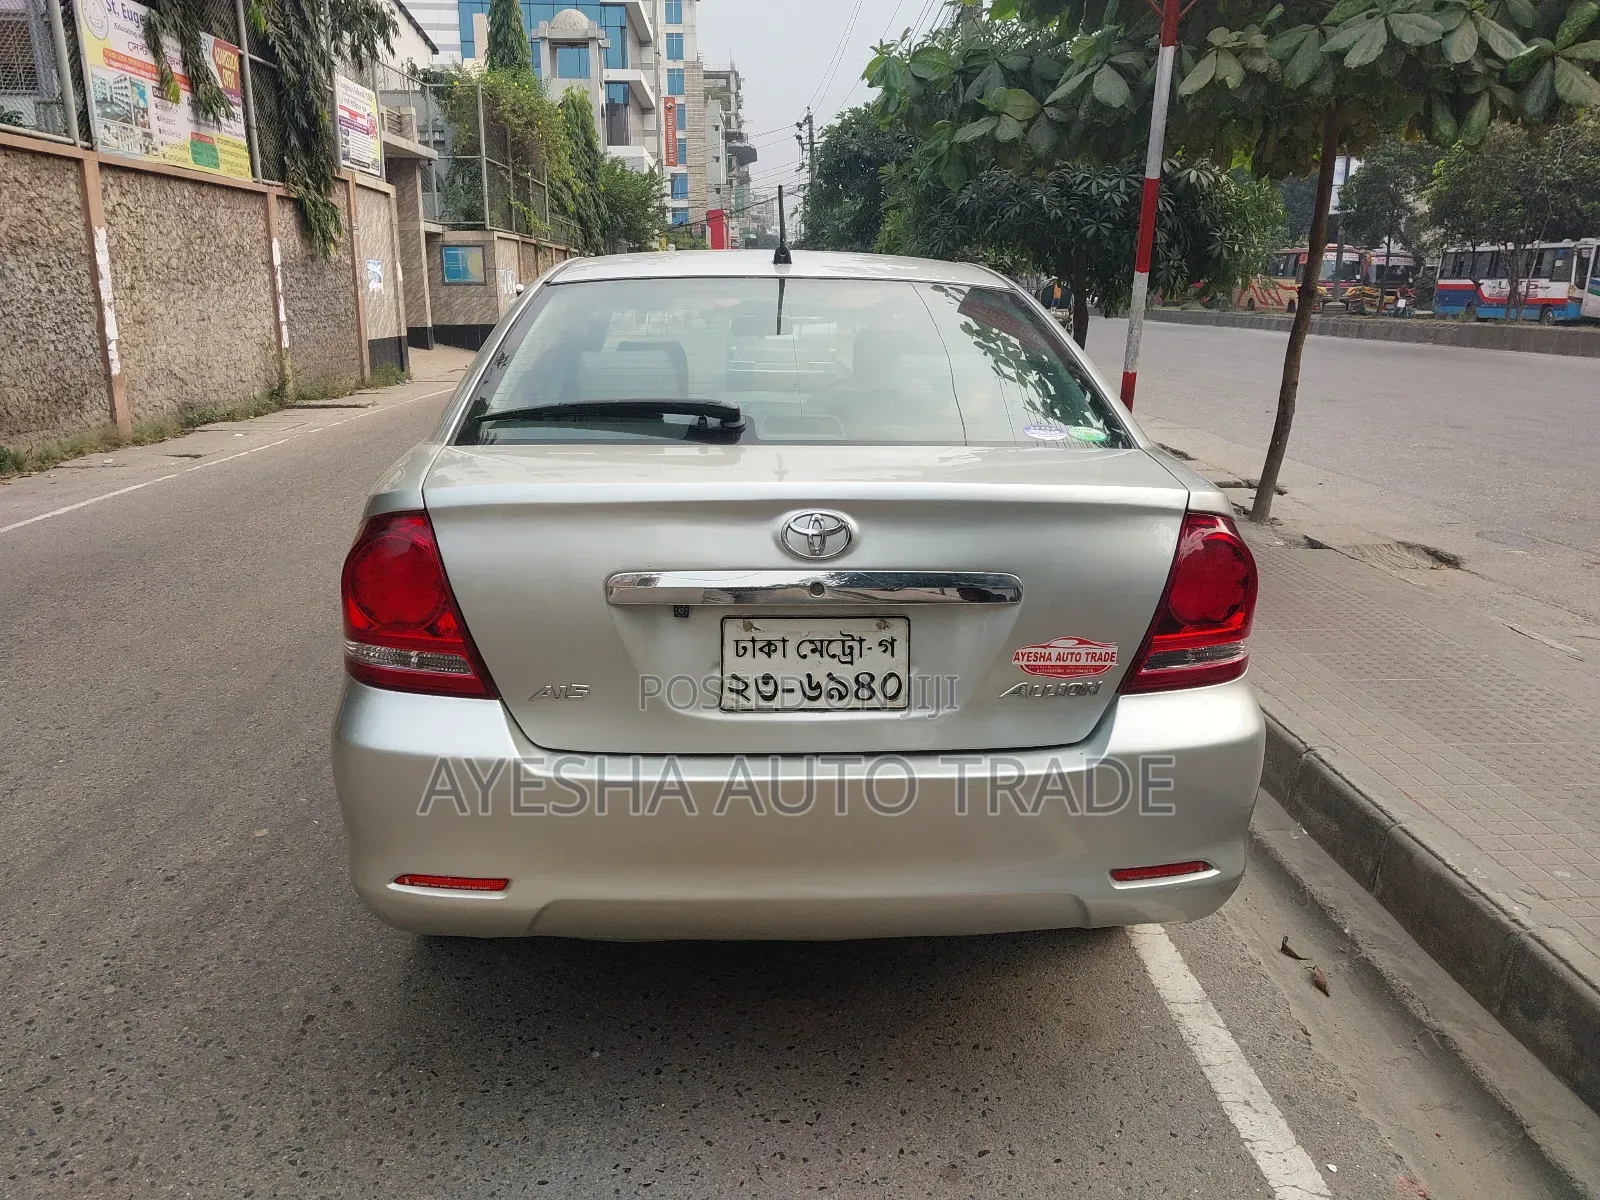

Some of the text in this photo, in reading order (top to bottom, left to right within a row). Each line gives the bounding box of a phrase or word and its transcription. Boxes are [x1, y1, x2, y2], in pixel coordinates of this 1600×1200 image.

[121, 3, 147, 28] Euge
[733, 636, 788, 660] ঢাকা
[1013, 651, 1116, 663] AYESHA AUTO TRADE
[999, 681, 1104, 698] ALLION
